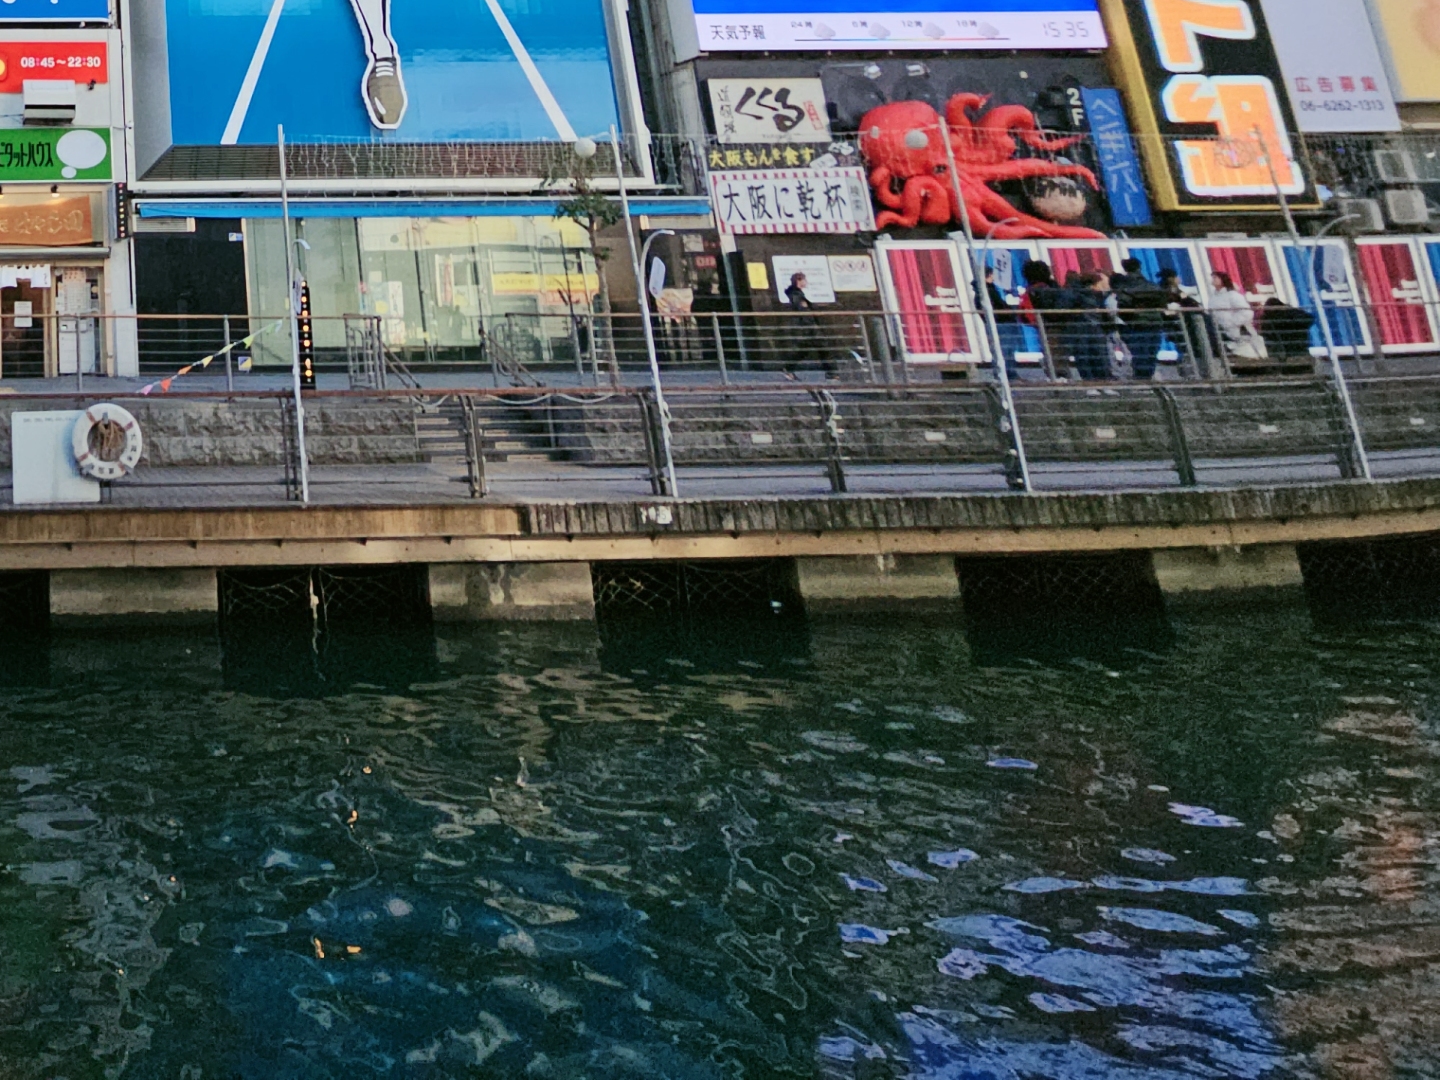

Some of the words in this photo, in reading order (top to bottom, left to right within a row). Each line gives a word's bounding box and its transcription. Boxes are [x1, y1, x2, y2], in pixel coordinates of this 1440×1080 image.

[710, 24, 766, 42] 天気予報
[735, 87, 805, 132] くくる
[723, 180, 846, 221] 大阪に乾杯
